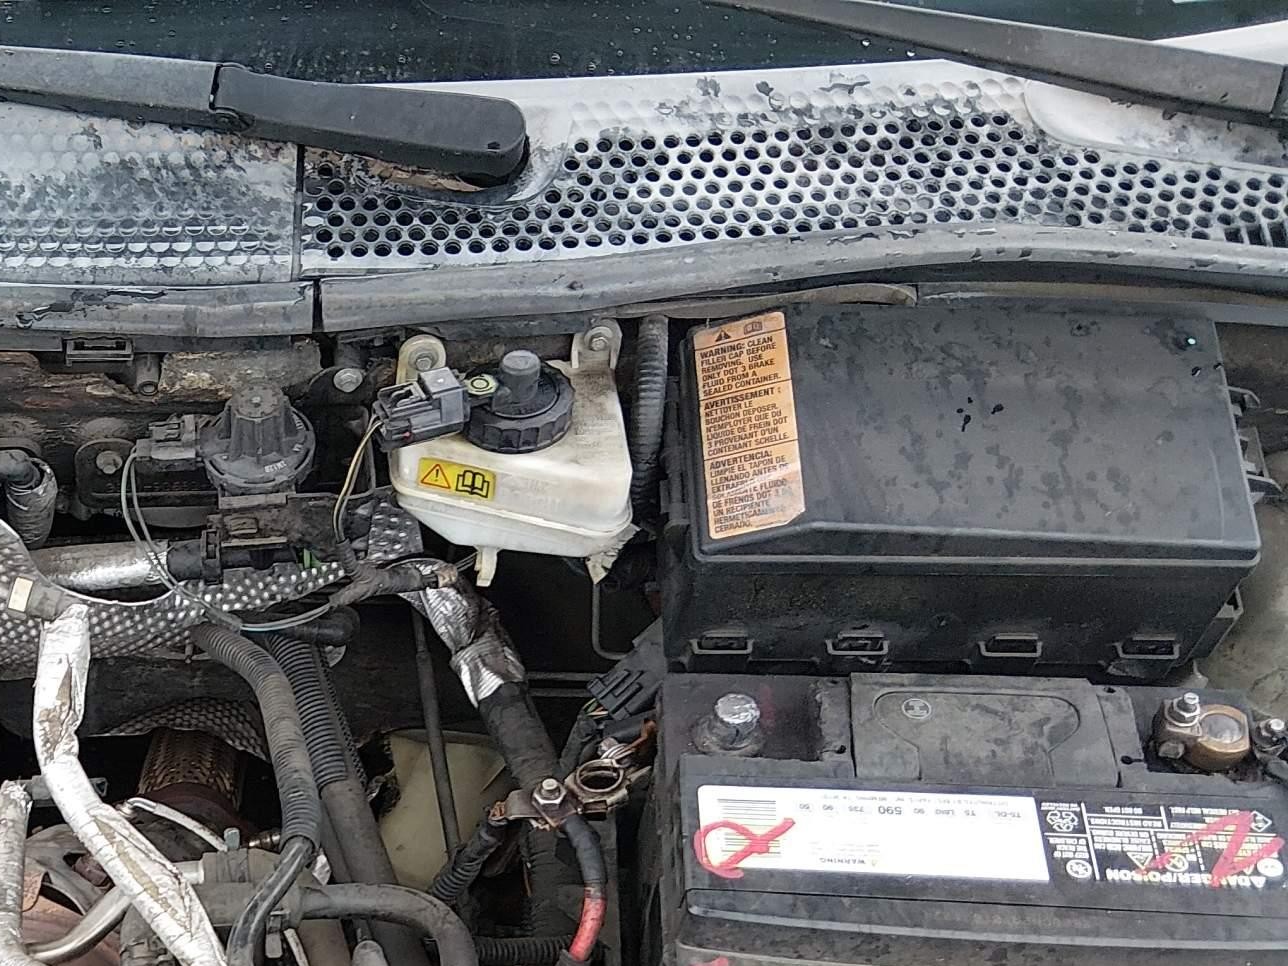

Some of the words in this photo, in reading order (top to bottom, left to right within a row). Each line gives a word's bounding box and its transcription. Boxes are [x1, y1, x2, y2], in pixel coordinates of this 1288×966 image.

[700, 343, 745, 359] WARNING:
[747, 336, 773, 347] CLEAN
[701, 356, 726, 366] FILLER
[729, 351, 744, 359] CAP
[746, 343, 776, 355] BEFORE
[702, 360, 744, 374] REMOVING.
[748, 354, 763, 362] USE
[702, 372, 722, 381] ONLY
[724, 367, 738, 376] DOT
[749, 359, 775, 370] BRAKE
[703, 380, 727, 389] FLUID
[727, 372, 749, 382] FROM
[704, 384, 732, 396] SEALED
[735, 373, 782, 388] CONTAINER.
[704, 388, 774, 410] AVERTISSEMENT
[705, 404, 742, 417] NETTOYER
[705, 412, 740, 425] BOUCHON
[706, 419, 752, 433] N'EMPLOYER
[755, 413, 769, 421] QUE
[772, 409, 781, 417] DU
[707, 429, 734, 441] LIQUIDE
[749, 420, 771, 430] FREIN
[773, 416, 788, 425] DOT
[714, 431, 758, 446] PROVENANT
[761, 427, 779, 436] D'UN
[708, 441, 752, 456] CONTENANT
[710, 450, 772, 470] ADVERTENCIA:
[710, 467, 735, 478] LIMPIE
[749, 458, 774, 468] TAPON
[711, 472, 750, 485] LLENANDO
[752, 466, 777, 476] ANTES
[724, 494, 754, 506] FRENOS
[878, 805, 902, 815] 590
